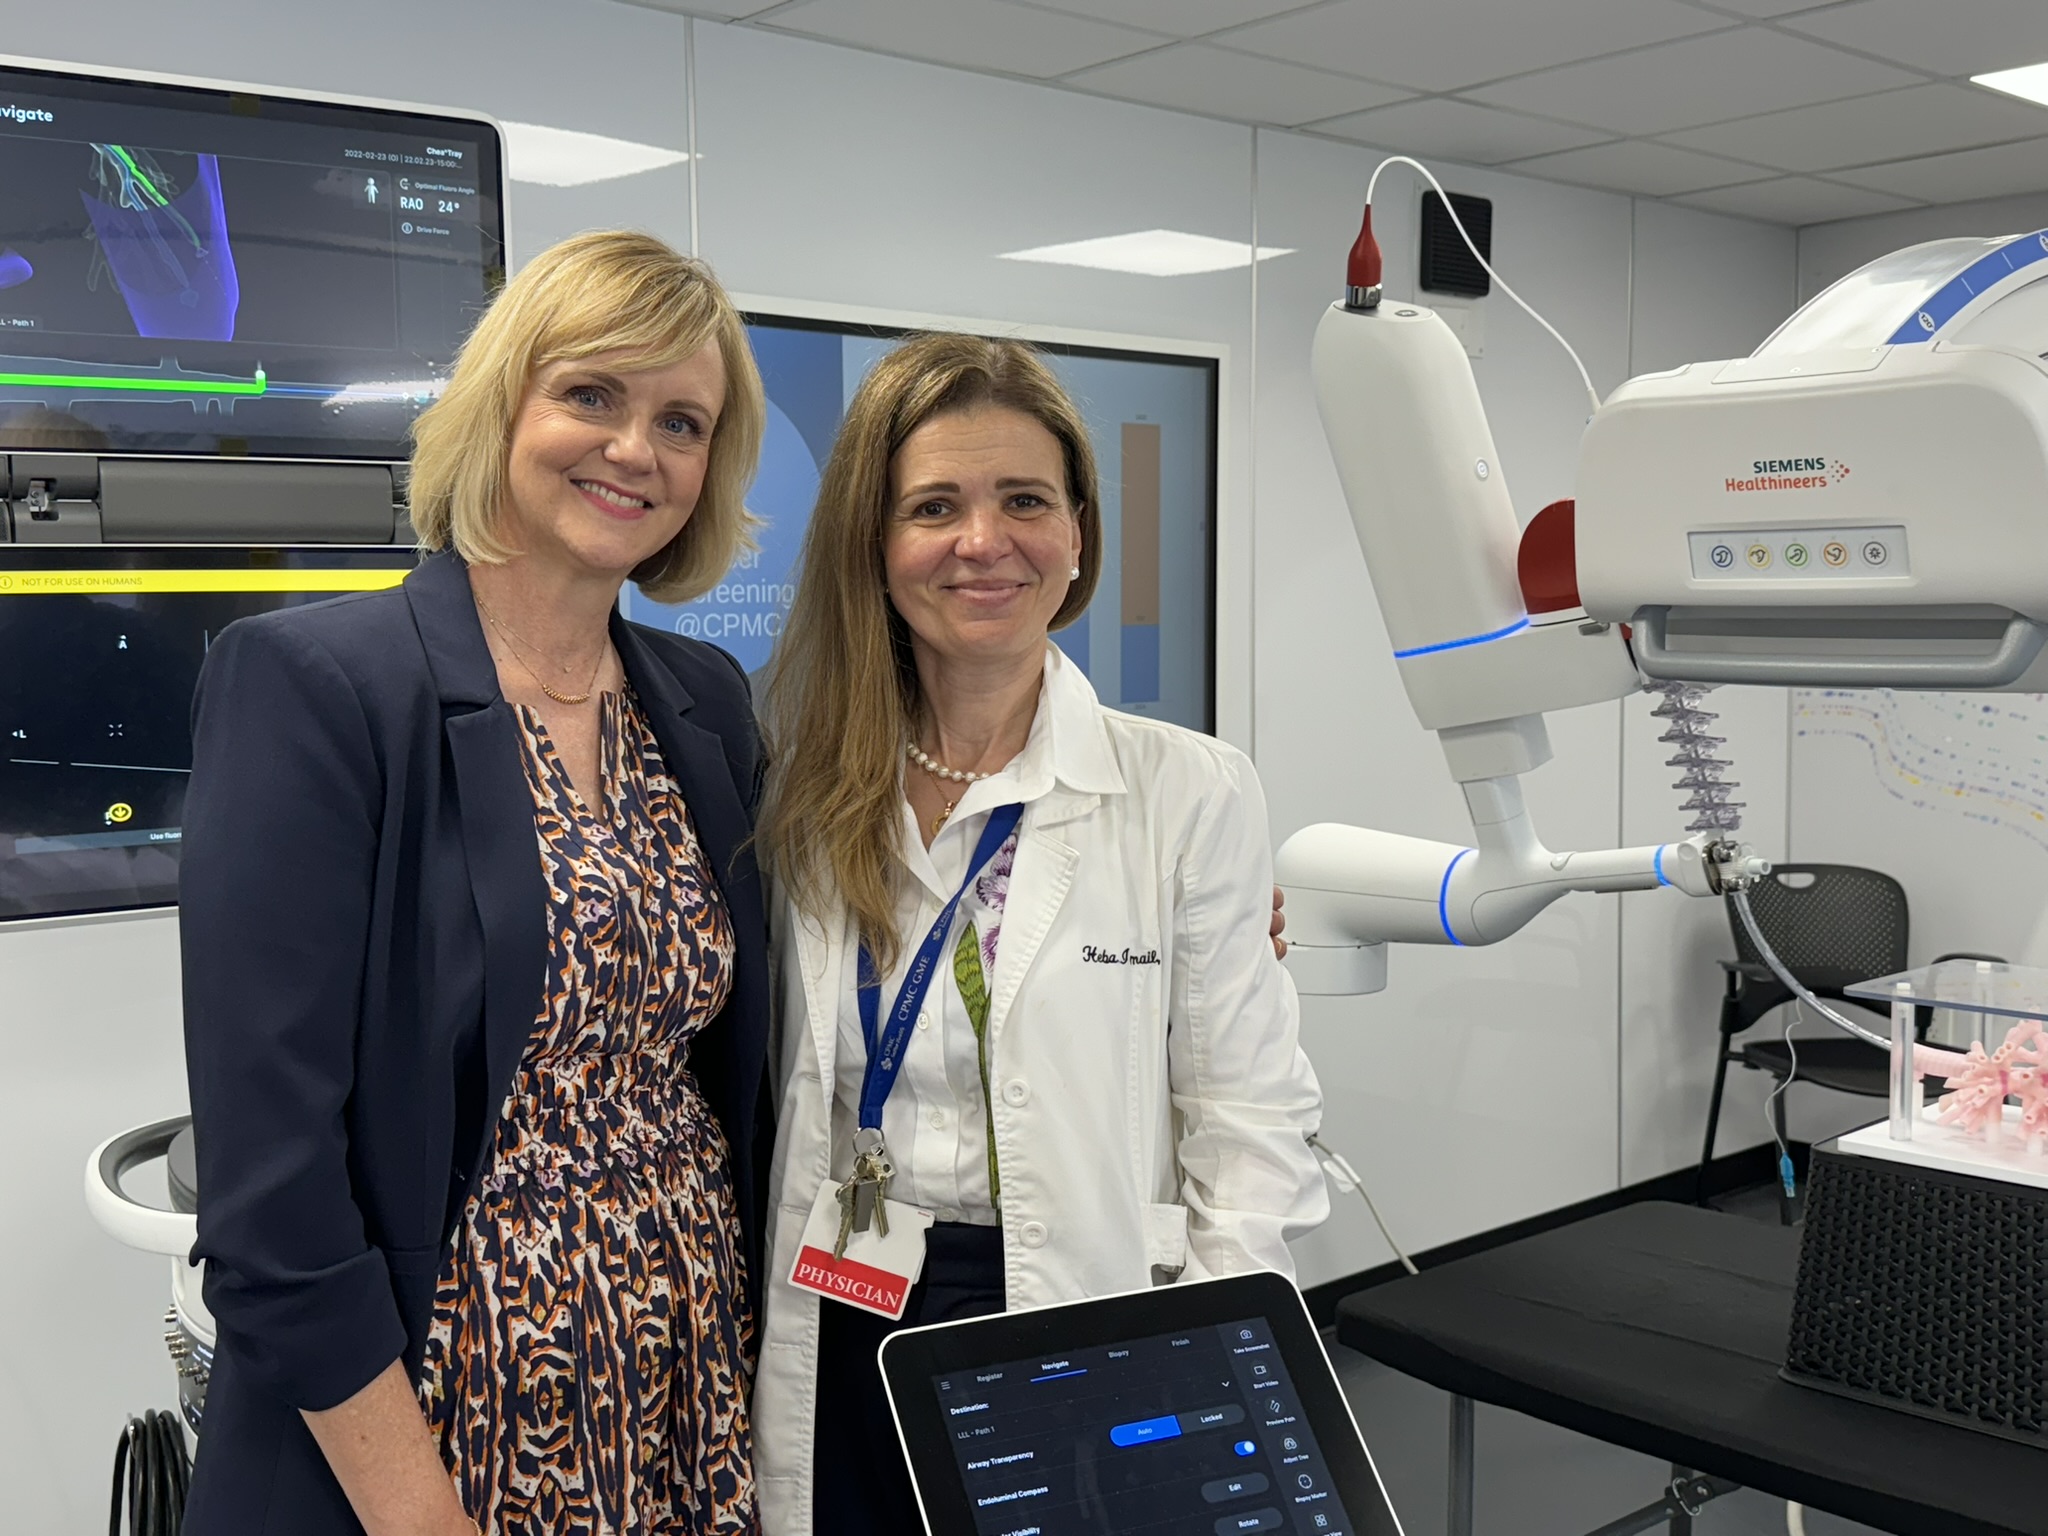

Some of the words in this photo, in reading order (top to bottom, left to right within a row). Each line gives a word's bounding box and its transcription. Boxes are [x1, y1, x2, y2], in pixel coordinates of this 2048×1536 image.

[400, 196, 424, 211] RAO
[12, 319, 29, 327] Path
[1753, 457, 1826, 474] SIEMENS
[1725, 474, 1828, 492] Healthineers
[21, 578, 42, 587] NOT
[44, 577, 63, 586] FOR
[65, 577, 84, 586] USE
[84, 577, 101, 586] ON
[102, 576, 144, 586] HUMANS
[150, 832, 164, 840] Use
[1082, 945, 1119, 964] Heba
[898, 985, 918, 1021] CPMC
[912, 956, 931, 984] GME
[796, 1262, 900, 1309] PHYSICIAN
[1041, 1360, 1070, 1371] Navigate
[976, 1372, 1003, 1382] Register
[950, 1402, 990, 1416] Destination:
[1200, 1413, 1224, 1425] Locked
[957, 1431, 970, 1440] LLL
[975, 1426, 991, 1436] Path
[1137, 1427, 1153, 1436] Auto
[967, 1459, 990, 1470] Airway
[990, 1451, 1034, 1466] Transparency
[1228, 1483, 1242, 1492] Edit
[977, 1492, 1018, 1507] Endoluminal
[1018, 1486, 1049, 1498] Compass
[1238, 1518, 1260, 1528] Rotate
